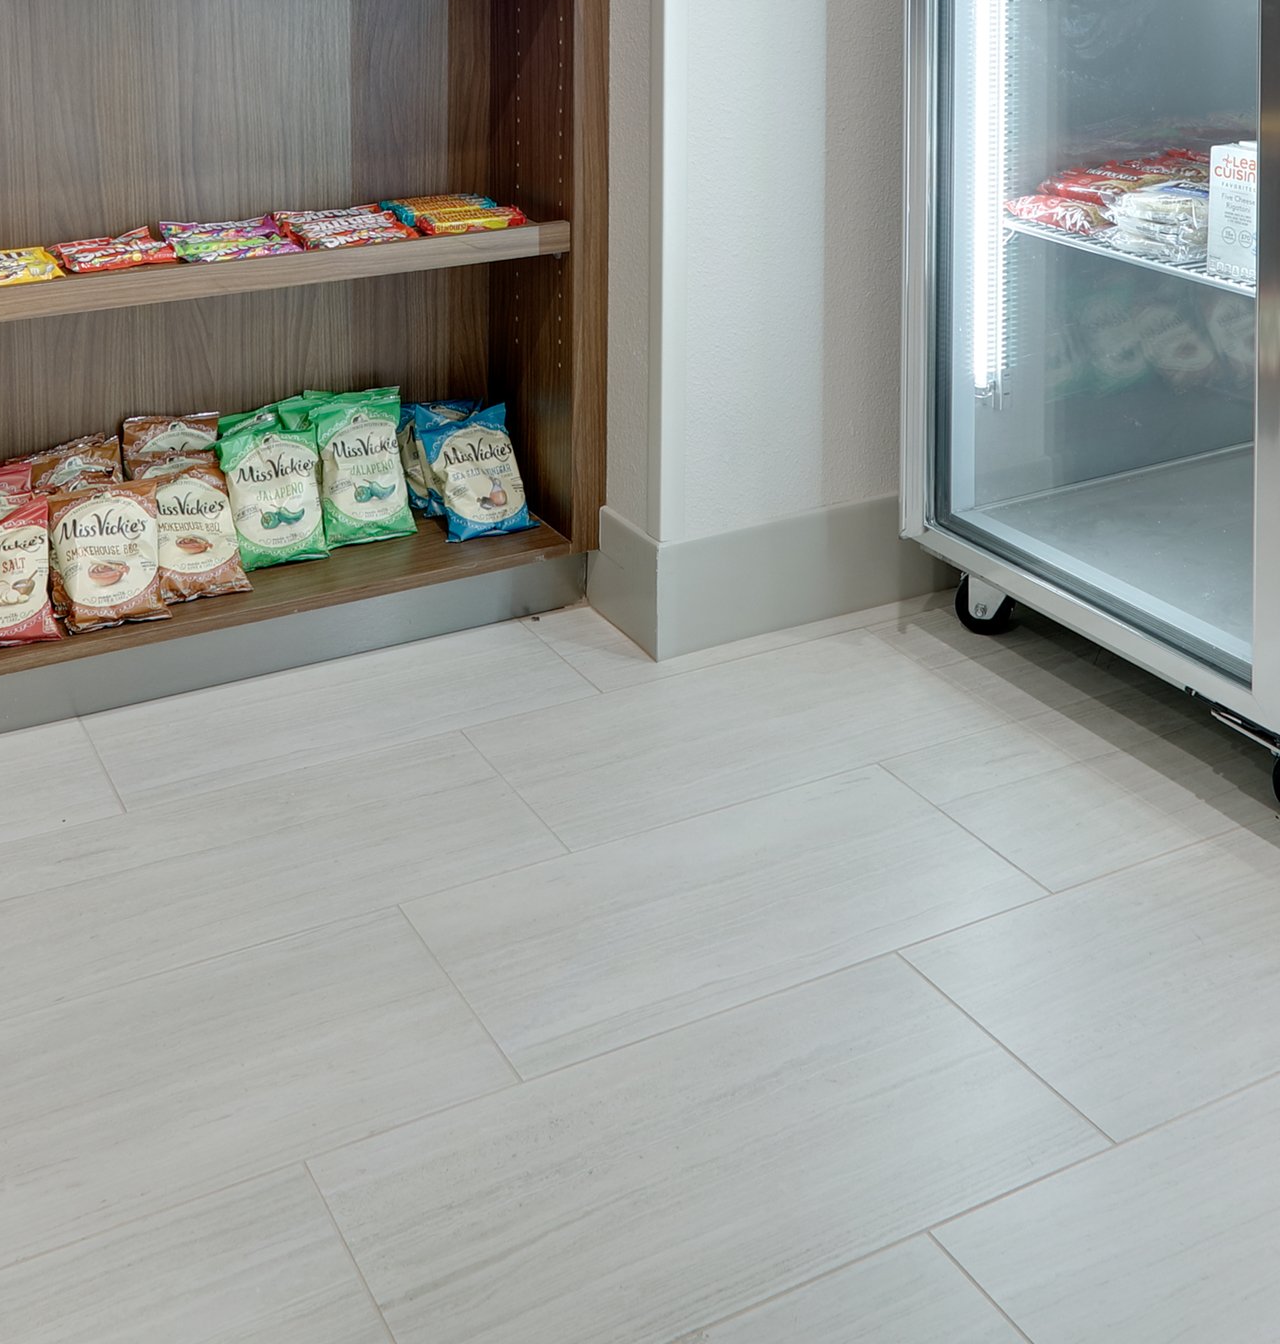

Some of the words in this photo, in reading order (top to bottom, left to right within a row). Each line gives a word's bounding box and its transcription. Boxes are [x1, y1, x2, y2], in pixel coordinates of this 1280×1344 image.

[1214, 166, 1256, 182] CUISIN
[332, 442, 362, 459] Miss
[443, 446, 470, 468] Miss
[468, 437, 513, 462] Vickie's
[237, 465, 273, 484] Miss
[271, 454, 316, 481] Vickie's
[174, 492, 225, 519] Vickie's
[59, 522, 97, 544] Miss
[94, 509, 147, 540] Vickie's
[65, 546, 120, 562] SMOKEHOUSE
[124, 543, 139, 556] BBQ
[2, 557, 26, 573] SALT
